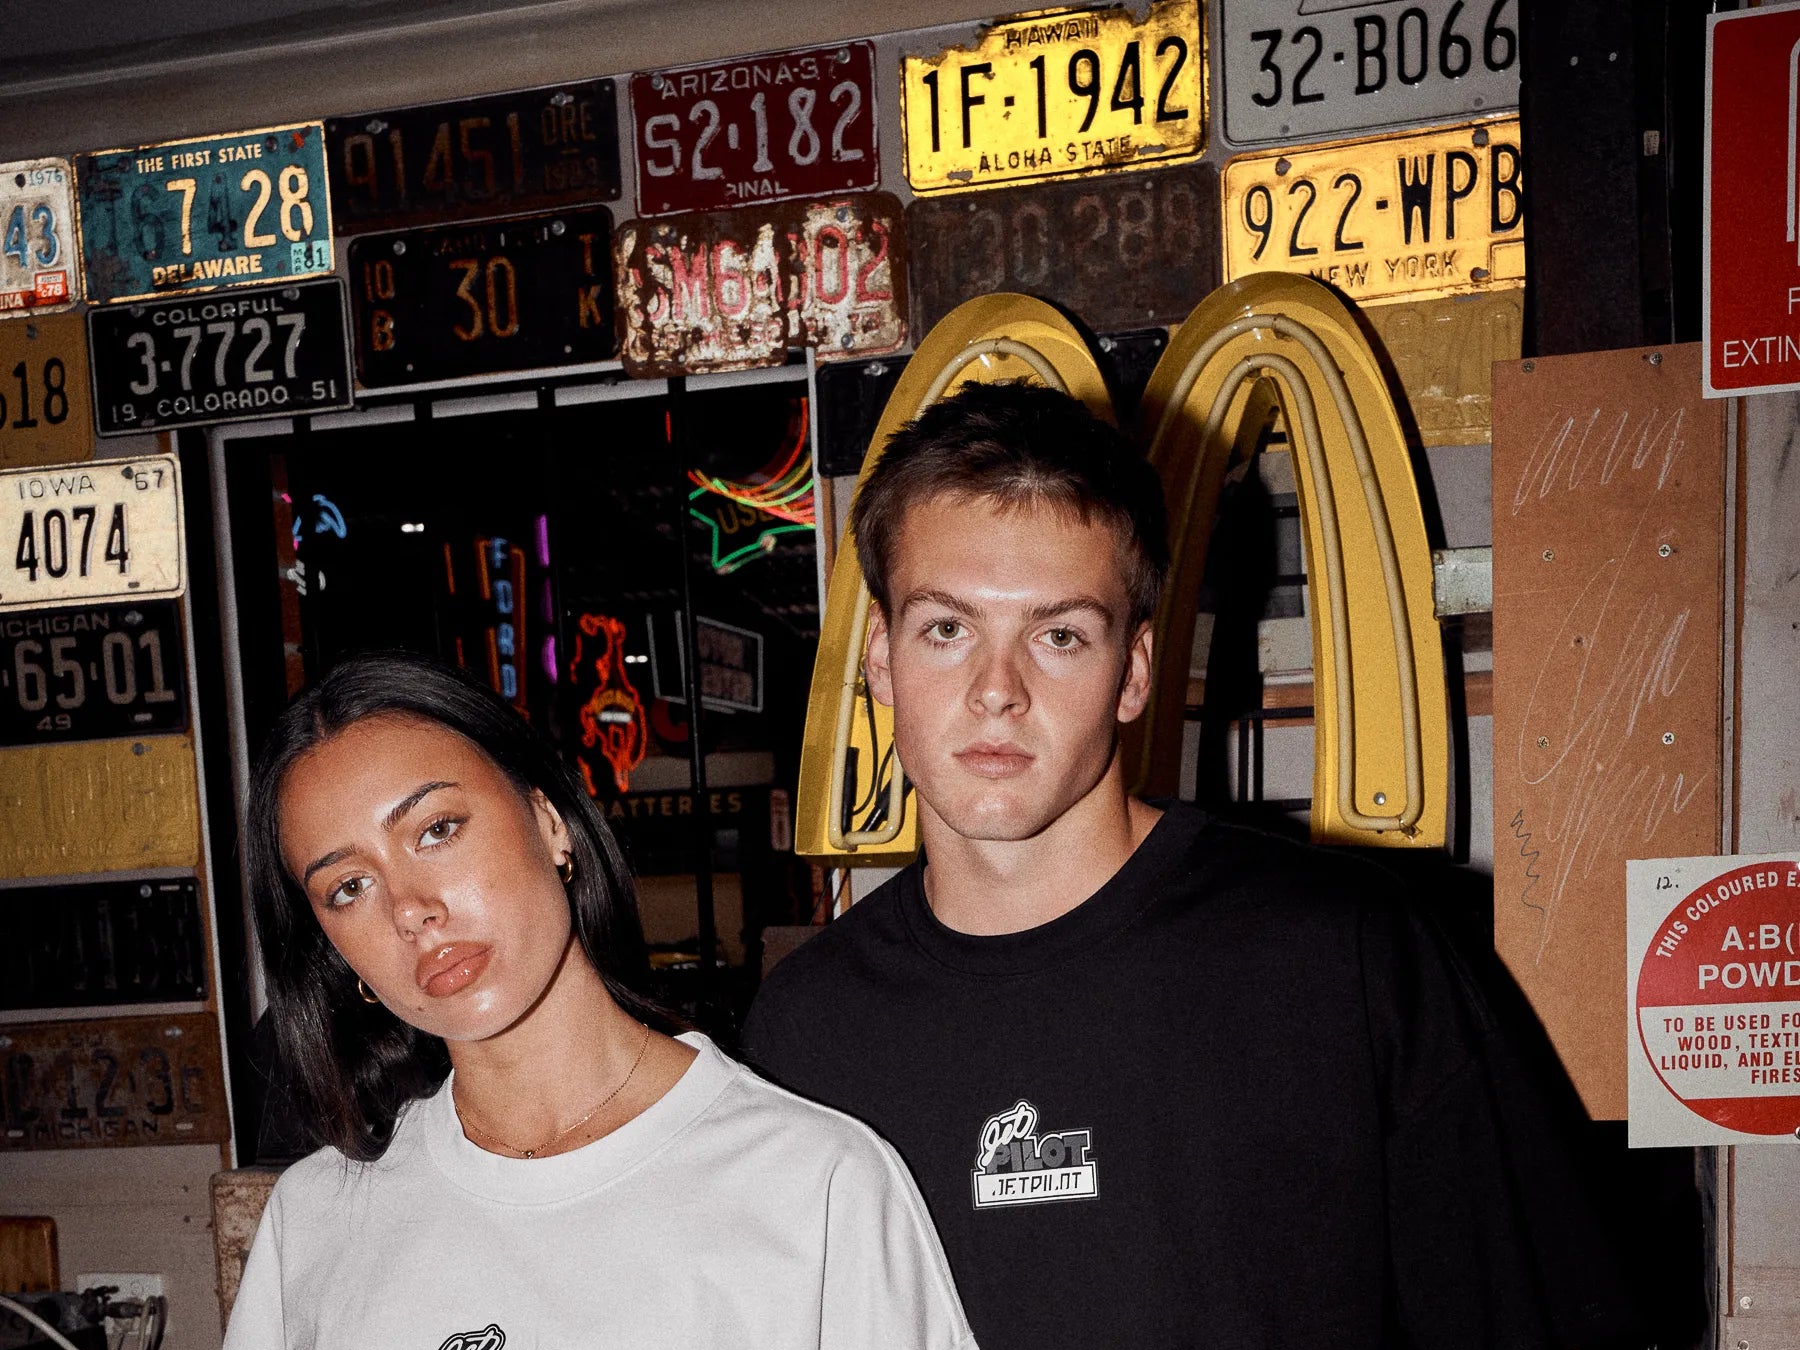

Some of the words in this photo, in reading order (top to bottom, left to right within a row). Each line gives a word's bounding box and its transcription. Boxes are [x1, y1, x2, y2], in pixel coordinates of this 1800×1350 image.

[1005, 18, 1099, 49] HAWAII
[136, 157, 163, 174] THE
[171, 150, 211, 168] FIRST
[218, 143, 263, 163] STATE
[978, 147, 1053, 174] ALOHA
[1065, 134, 1133, 163] STATE
[28, 167, 63, 186] 1976
[152, 254, 263, 286] DELAWARE
[1310, 260, 1370, 288] NEW
[1386, 249, 1458, 281] YORK
[152, 299, 284, 326] COLORFUL
[449, 255, 520, 343] 30
[156, 386, 288, 417] COLORADO
[18, 474, 96, 499] IOWA
[16, 503, 131, 582] 4074
[595, 793, 742, 820] ATTERES
[1656, 920, 1689, 958] THIS
[1686, 871, 1778, 921] COLOURED
[1786, 871, 1800, 888] E
[1698, 961, 1800, 990] POWD
[1664, 1017, 1684, 1033] TO
[1695, 1017, 1715, 1032] BE
[1724, 1014, 1770, 1031] USED
[1678, 1035, 1740, 1052] WOOD,
[1661, 1053, 1728, 1071] LIQUID,
[1738, 1051, 1774, 1068] AND
[986, 1135, 1088, 1174] PILOT
